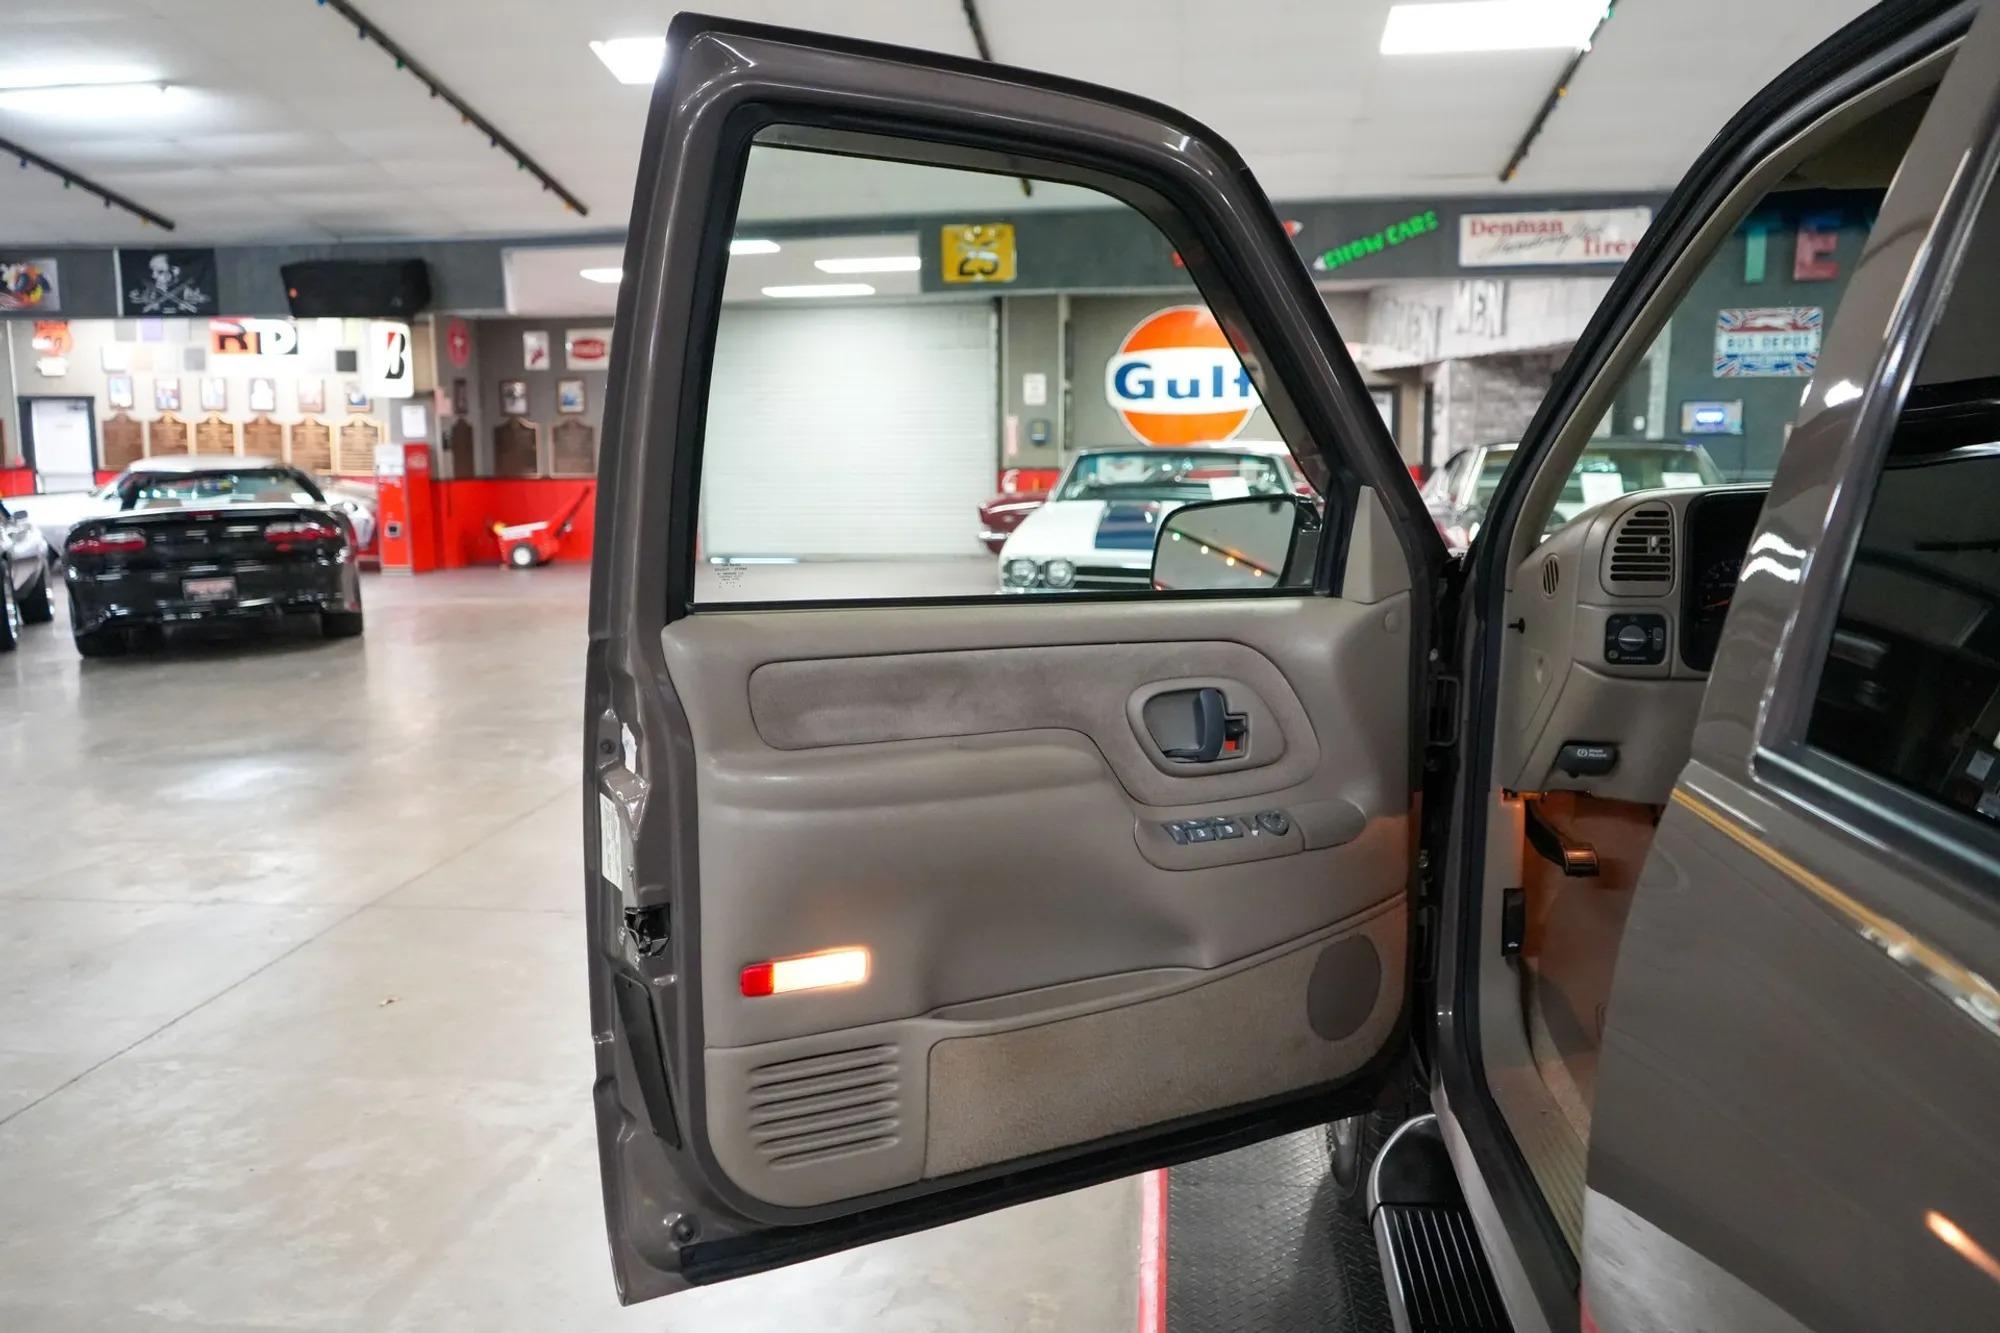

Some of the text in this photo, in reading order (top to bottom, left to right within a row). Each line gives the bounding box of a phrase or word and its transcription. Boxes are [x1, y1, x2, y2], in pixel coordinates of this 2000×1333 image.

[1324, 210, 1439, 270] SHOW CARS
[1470, 217, 1564, 237] Denman
[1454, 279, 1511, 338] MEN
